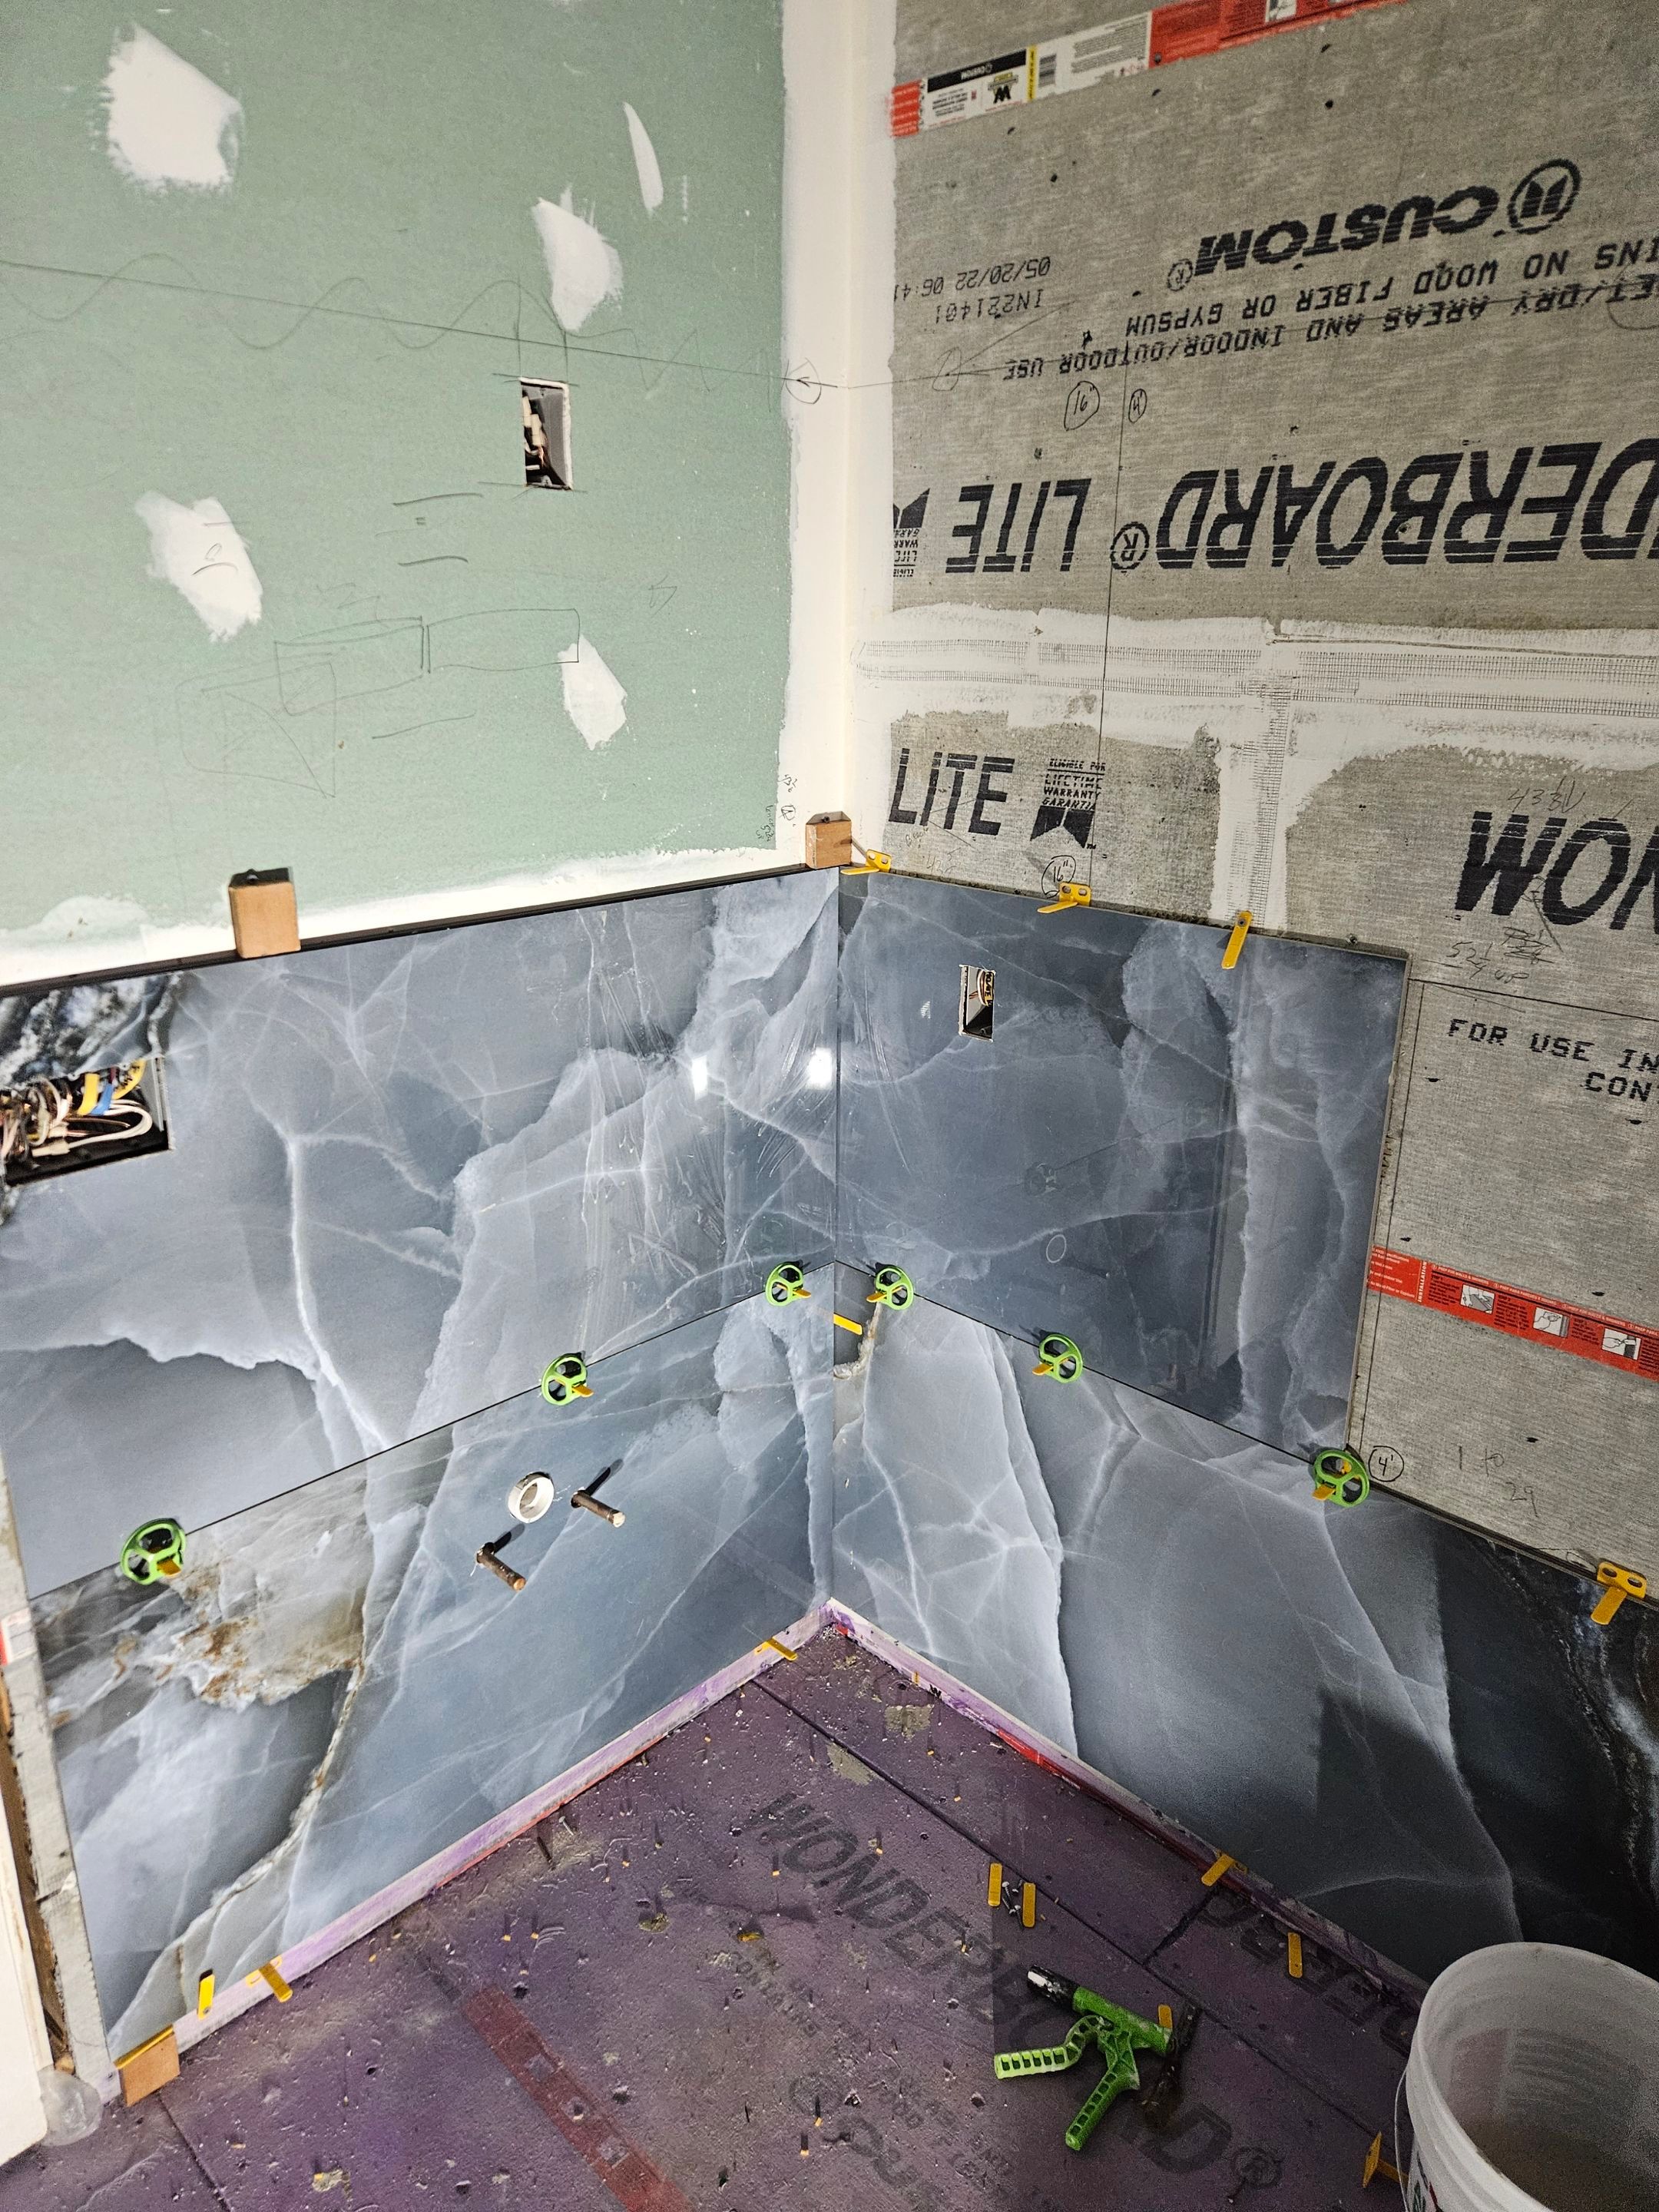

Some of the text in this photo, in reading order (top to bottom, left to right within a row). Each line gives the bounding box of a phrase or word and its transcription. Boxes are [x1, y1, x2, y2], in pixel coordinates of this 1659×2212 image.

[955, 257, 1051, 290] 05/20/22
[1415, 260, 1497, 295] WOOD
[1523, 249, 1568, 280] NO
[1243, 294, 1276, 318] OR
[1296, 277, 1394, 313] FIBER
[1125, 303, 1224, 338] GYPSUM
[1306, 313, 1363, 338] AND
[1383, 299, 1488, 332] AREAS
[1058, 323, 1286, 374] INDOOR/OUTDOOR
[1004, 356, 1044, 380] USE
[945, 478, 1091, 575] LITE
[888, 747, 1015, 836] LITE
[1043, 786, 1101, 800] WARRANTY
[1045, 773, 1103, 790] LIFETIME
[1447, 1018, 1659, 1075] FOR USE IN
[1584, 1071, 1659, 1102] CON
[1417, 1261, 1427, 1303] INSTALLATION
